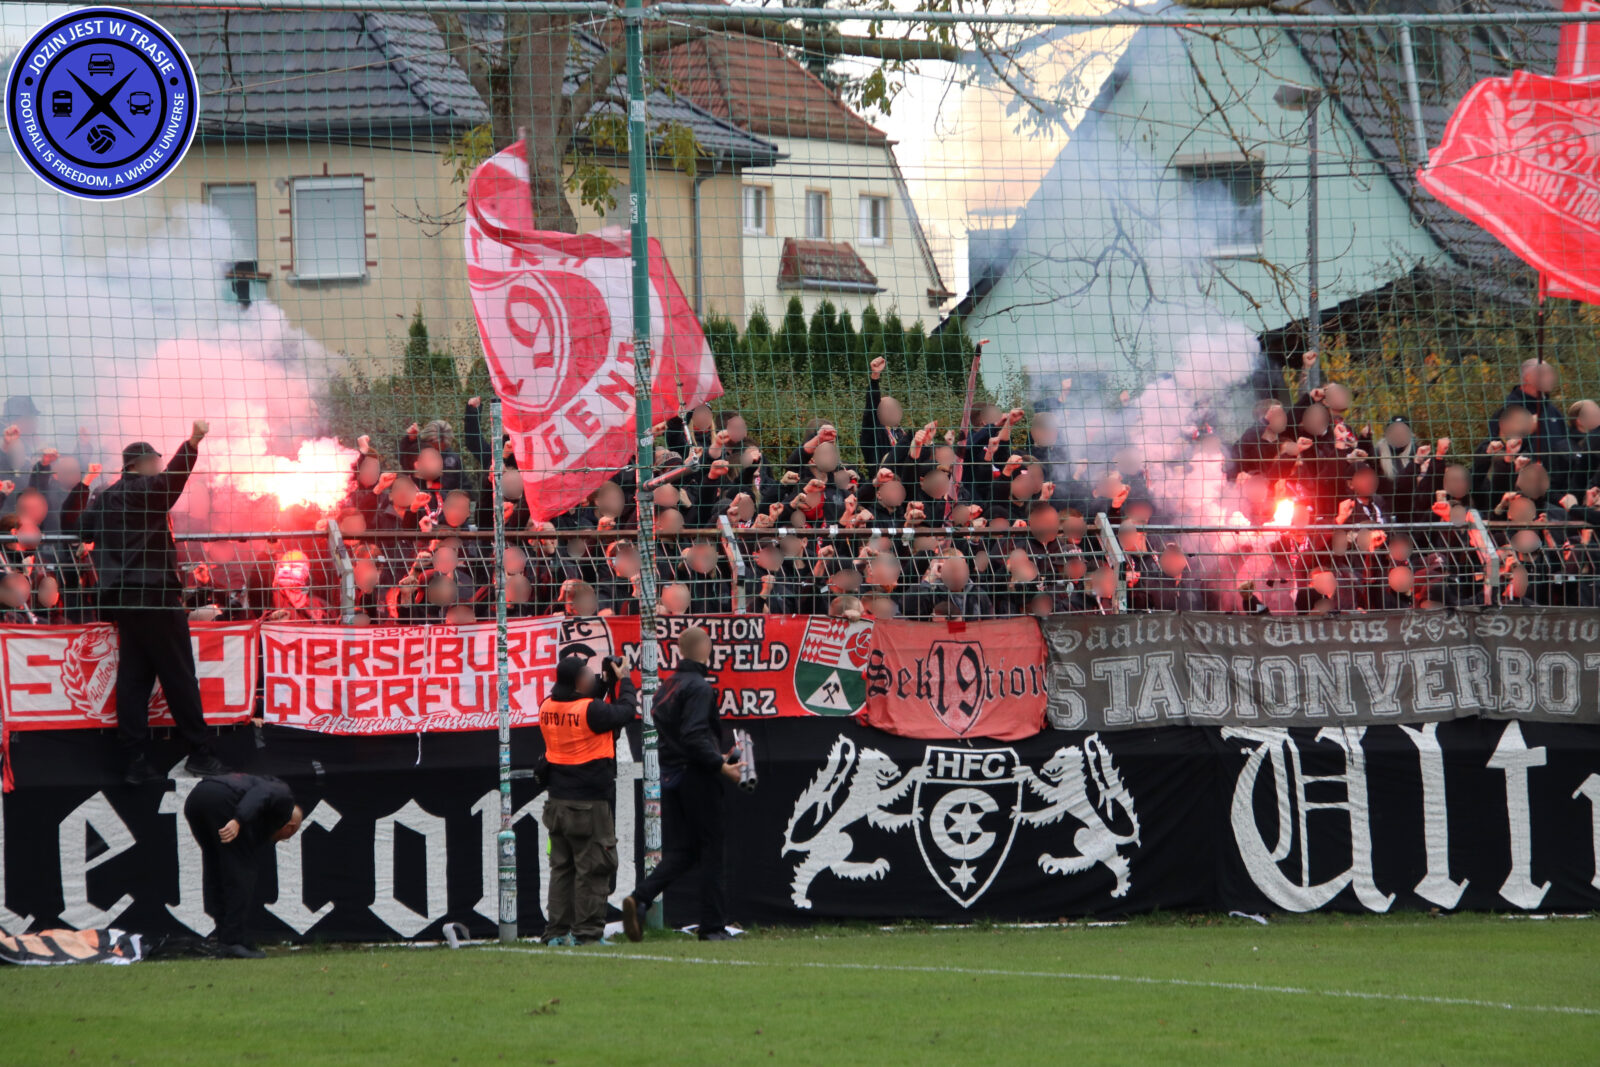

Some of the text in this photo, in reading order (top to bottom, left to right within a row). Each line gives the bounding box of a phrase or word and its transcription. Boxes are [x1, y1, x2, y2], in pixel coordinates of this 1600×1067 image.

[372, 626, 459, 638] SEKTION
[560, 621, 593, 642] FC
[265, 627, 558, 677] MERSEBURG
[265, 667, 557, 721] QUERFURT
[932, 644, 981, 717] 19
[936, 752, 1006, 779] HFC
